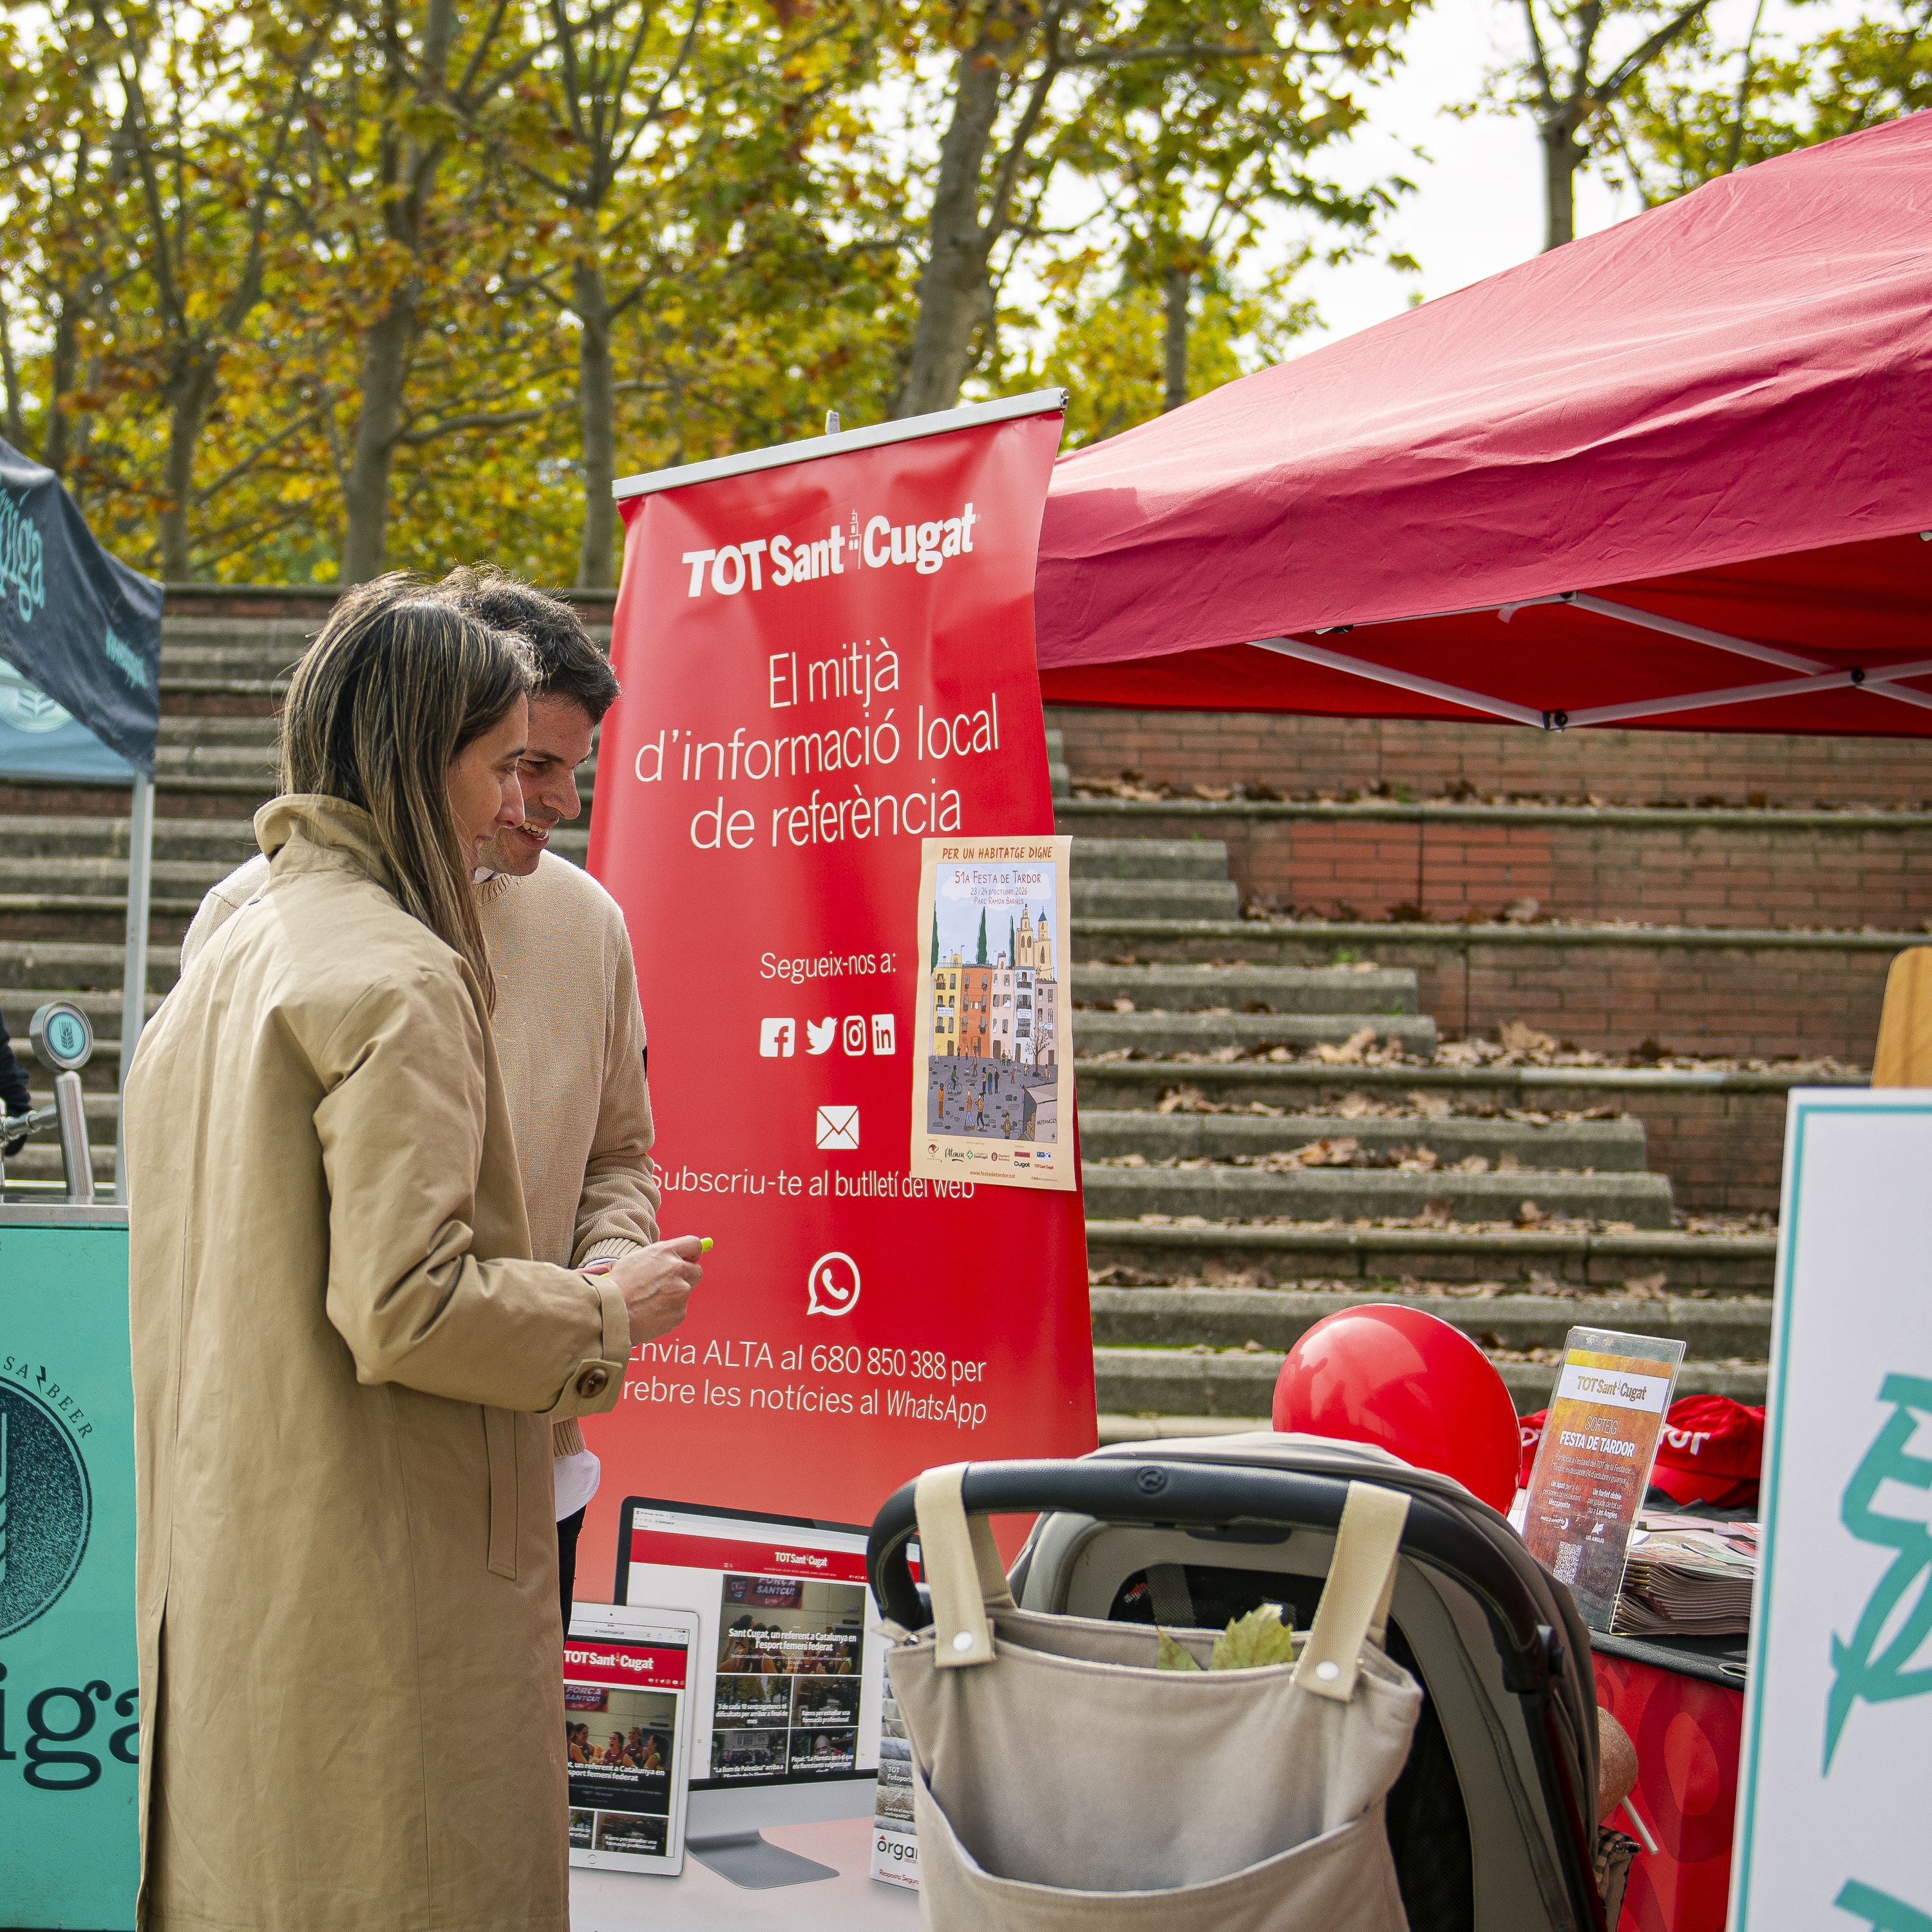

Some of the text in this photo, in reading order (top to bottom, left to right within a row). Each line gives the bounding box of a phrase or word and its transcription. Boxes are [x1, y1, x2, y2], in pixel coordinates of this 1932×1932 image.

[682, 502, 976, 598] TOT Sant Cugat
[770, 637, 899, 708] El mitjà
[634, 692, 999, 782] d'informació local
[690, 778, 961, 849] de referència
[942, 846, 1053, 859] PER UN HABITATGE DIGNE
[1015, 887, 1028, 895] 2026
[759, 951, 897, 984] Segueix-nos a:
[1037, 1117, 1057, 1126] MUDANCES
[651, 1163, 974, 1198] Subscriu-te al butlletí del web
[969, 1171, 1016, 1179] www.festadetardor.cat
[703, 1339, 775, 1370] ALTA
[781, 1344, 802, 1370] al
[811, 1345, 861, 1374] 680
[867, 1347, 906, 1377] 850
[910, 1350, 946, 1380] 388
[951, 1359, 987, 1387] per
[1578, 1376, 1647, 1401] TOT Sant Cugat
[46, 1383, 93, 1439] BEER
[623, 1376, 987, 1430] rebre les notícies al WhatsApp
[1585, 1416, 1618, 1435] SORTEIG
[1559, 1430, 1586, 1448] FESTA
[1586, 1435, 1600, 1451] DE
[1600, 1437, 1635, 1458] TARDOR
[1585, 1469, 1591, 1477] 24
[1610, 1491, 1622, 1501] doble
[1604, 1510, 1618, 1519] Angles
[775, 1551, 828, 1567] TOT Sant Cugat
[728, 1628, 746, 1638] Sant
[746, 1629, 770, 1641] Cugat,
[781, 1631, 810, 1640] referent
[815, 1632, 849, 1643] Catalunya
[755, 1638, 833, 1651] l'esport femení federat
[564, 1650, 654, 1671] TOT Sant Cugat
[584, 1763, 613, 1772] referent
[620, 1766, 655, 1776] Catalunya
[612, 1773, 638, 1781] federat
